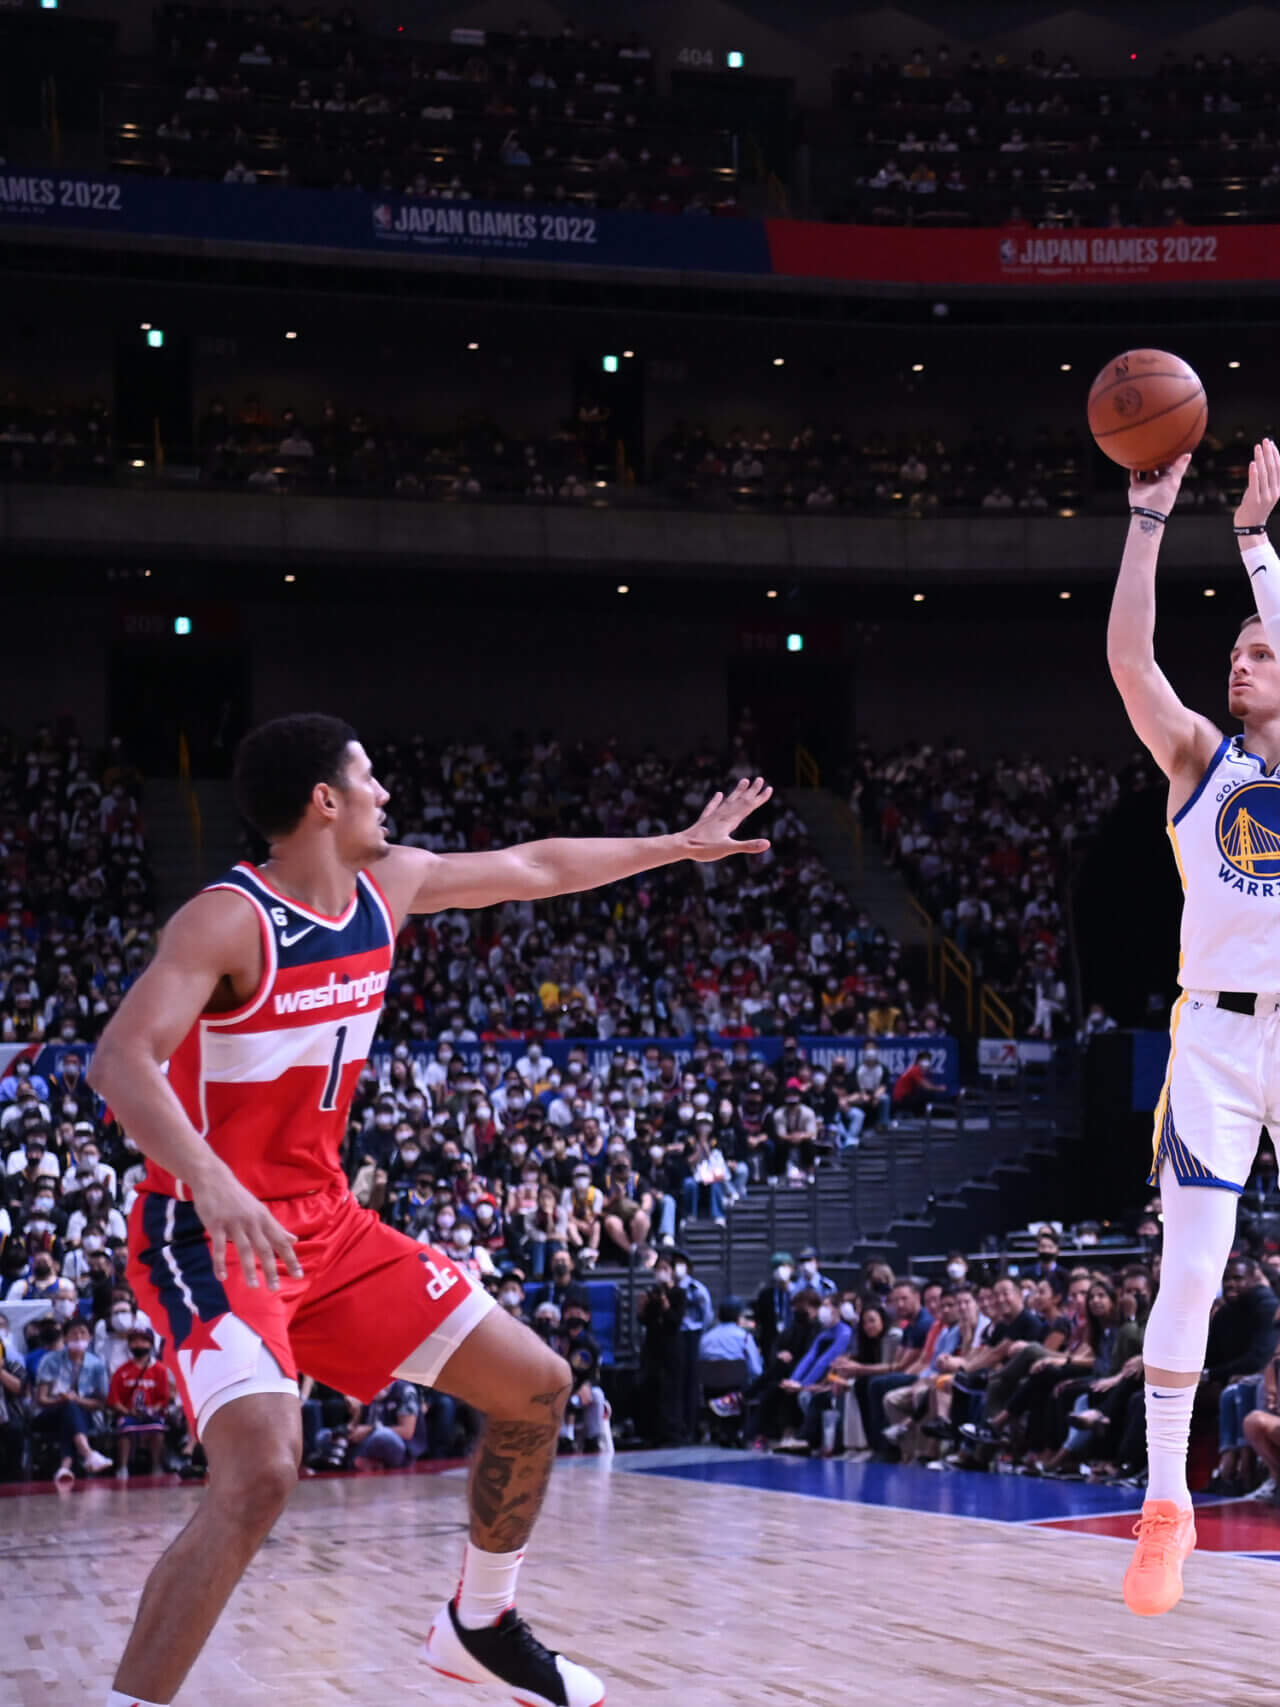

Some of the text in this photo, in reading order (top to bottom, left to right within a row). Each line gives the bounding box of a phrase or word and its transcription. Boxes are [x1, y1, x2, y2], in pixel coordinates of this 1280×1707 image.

[59, 179, 123, 211] 2022
[394, 205, 465, 234] JAPAN
[467, 209, 538, 240] GAMES
[540, 215, 598, 244] 2022
[1020, 236, 1218, 264] JAPAN GAMES 2022
[1215, 779, 1248, 802] GOL
[270, 906, 289, 927] 6
[318, 1025, 348, 1112] 1
